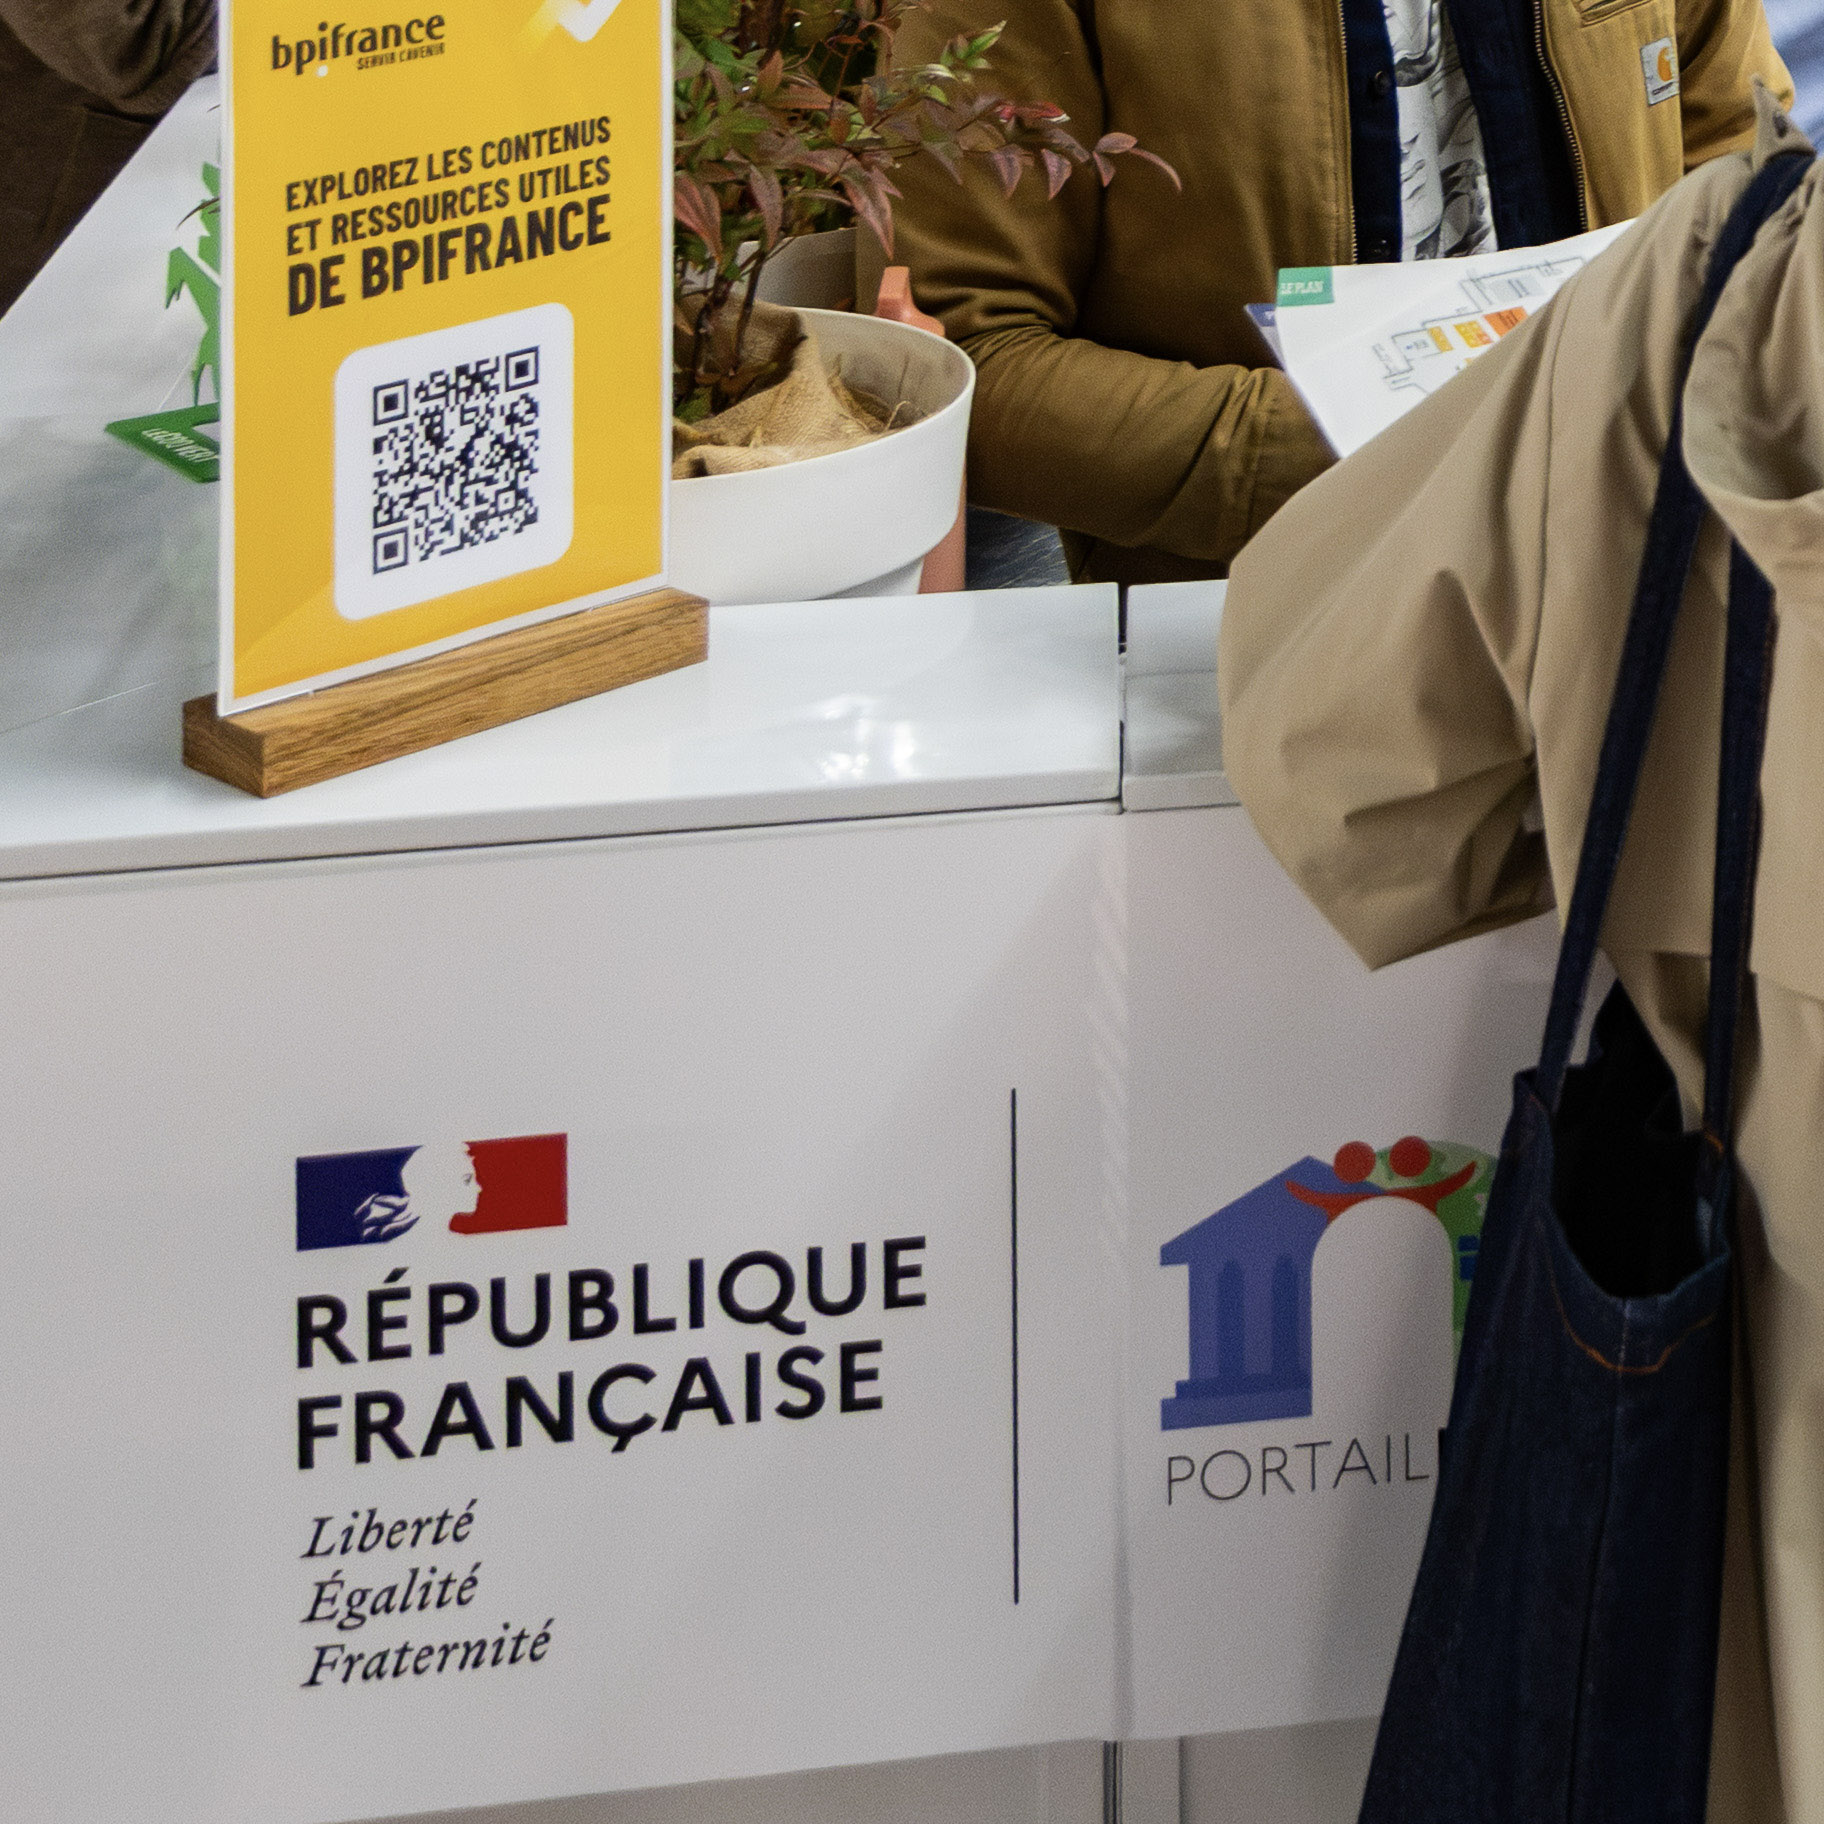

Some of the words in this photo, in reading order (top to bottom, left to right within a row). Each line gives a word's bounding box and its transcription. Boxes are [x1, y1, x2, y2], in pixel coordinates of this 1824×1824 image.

[272, 15, 446, 76] bpifrance
[286, 156, 419, 212] EXPLOREZ
[426, 146, 473, 182] LES
[481, 115, 611, 169] CONTENUS
[286, 218, 323, 256] ET
[331, 177, 510, 245] RESSOURCES
[518, 155, 611, 203] UTILES
[288, 254, 346, 317] DE
[361, 193, 611, 300] BPIFRANCE
[296, 1235, 928, 1370] RÉPUBLIQUE
[297, 1340, 884, 1470] FRANÇAISE
[1167, 1433, 1430, 1506] PORTAIL
[301, 1499, 478, 1559] Liberté
[301, 1562, 482, 1631] Égalité
[301, 1618, 555, 1688] Fraternité
